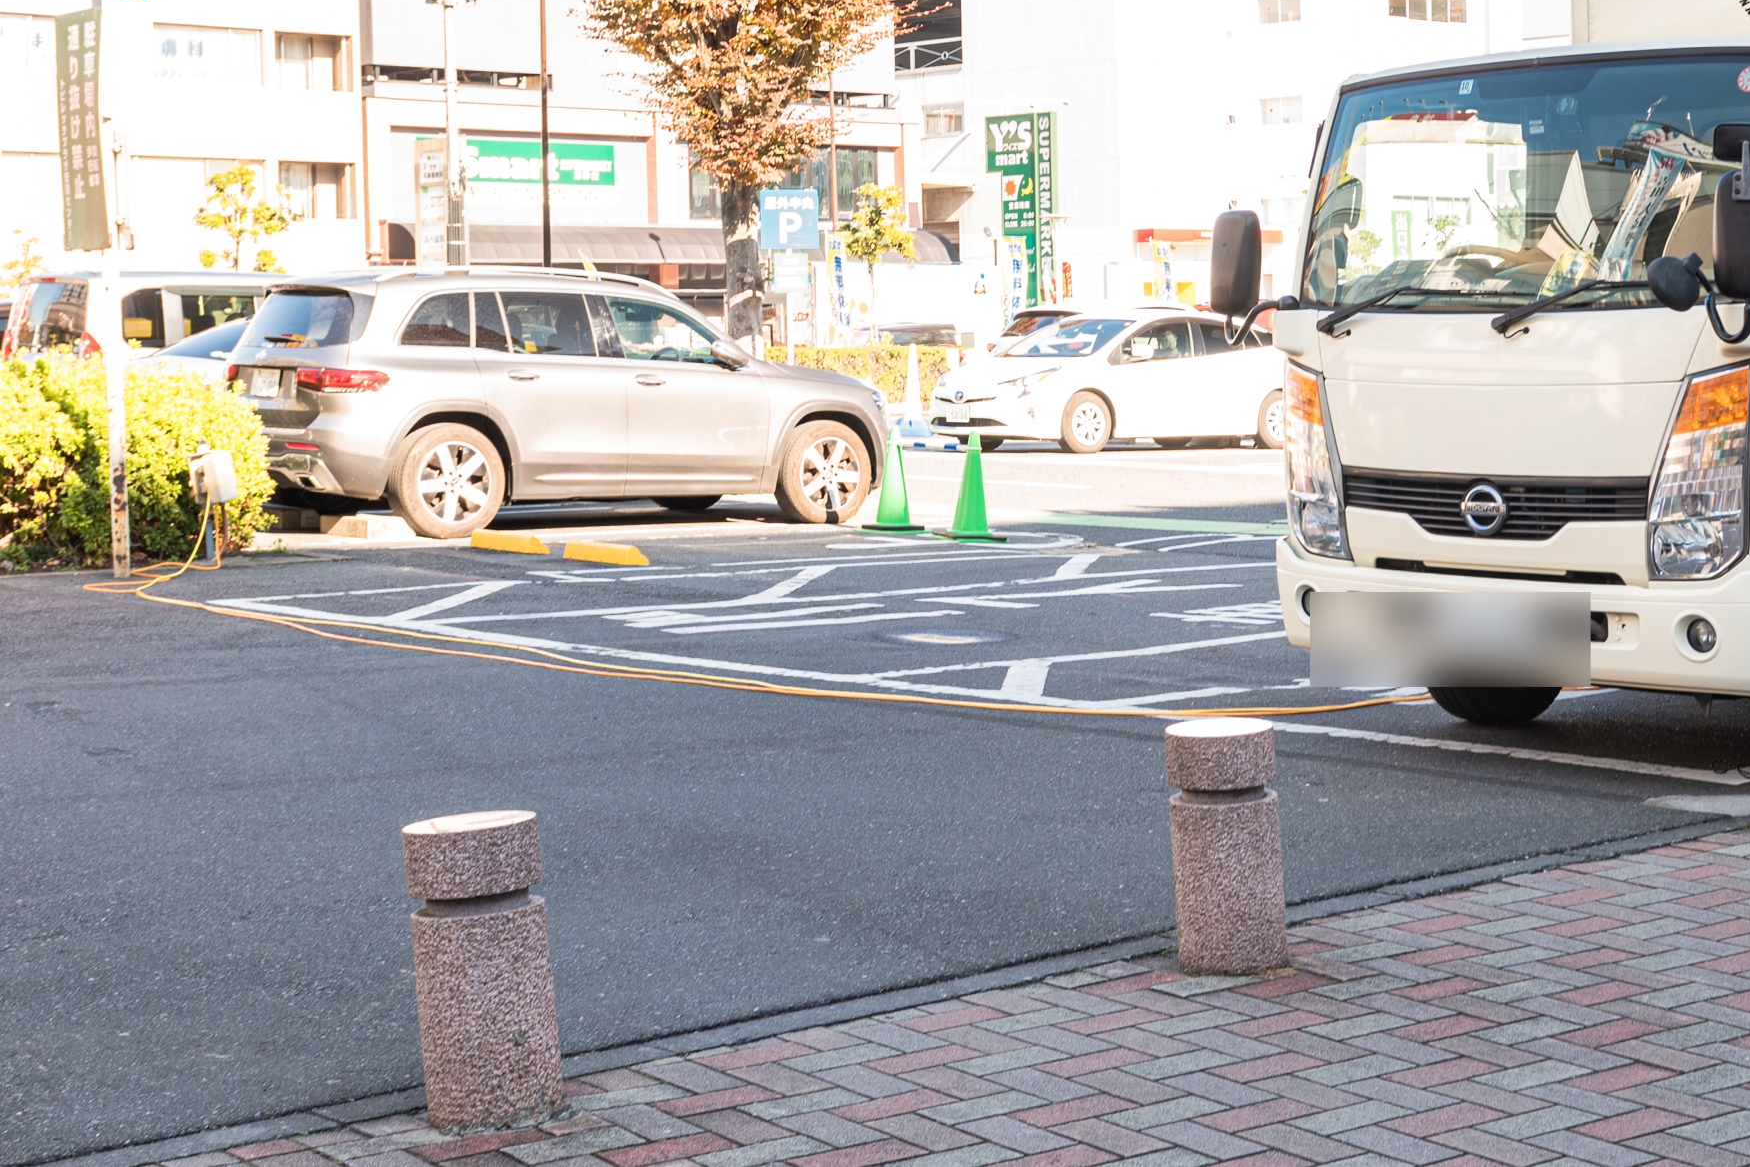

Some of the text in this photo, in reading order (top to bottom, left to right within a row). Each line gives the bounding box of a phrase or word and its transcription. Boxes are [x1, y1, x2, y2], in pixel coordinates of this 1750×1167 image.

[67, 24, 85, 200] 通り抜け禁止
[83, 20, 97, 138] 駐車場内
[995, 150, 1029, 166] mart
[1038, 116, 1051, 272] SUPERMARKE
[778, 211, 803, 245] P
[1465, 505, 1500, 514] NISSAN
